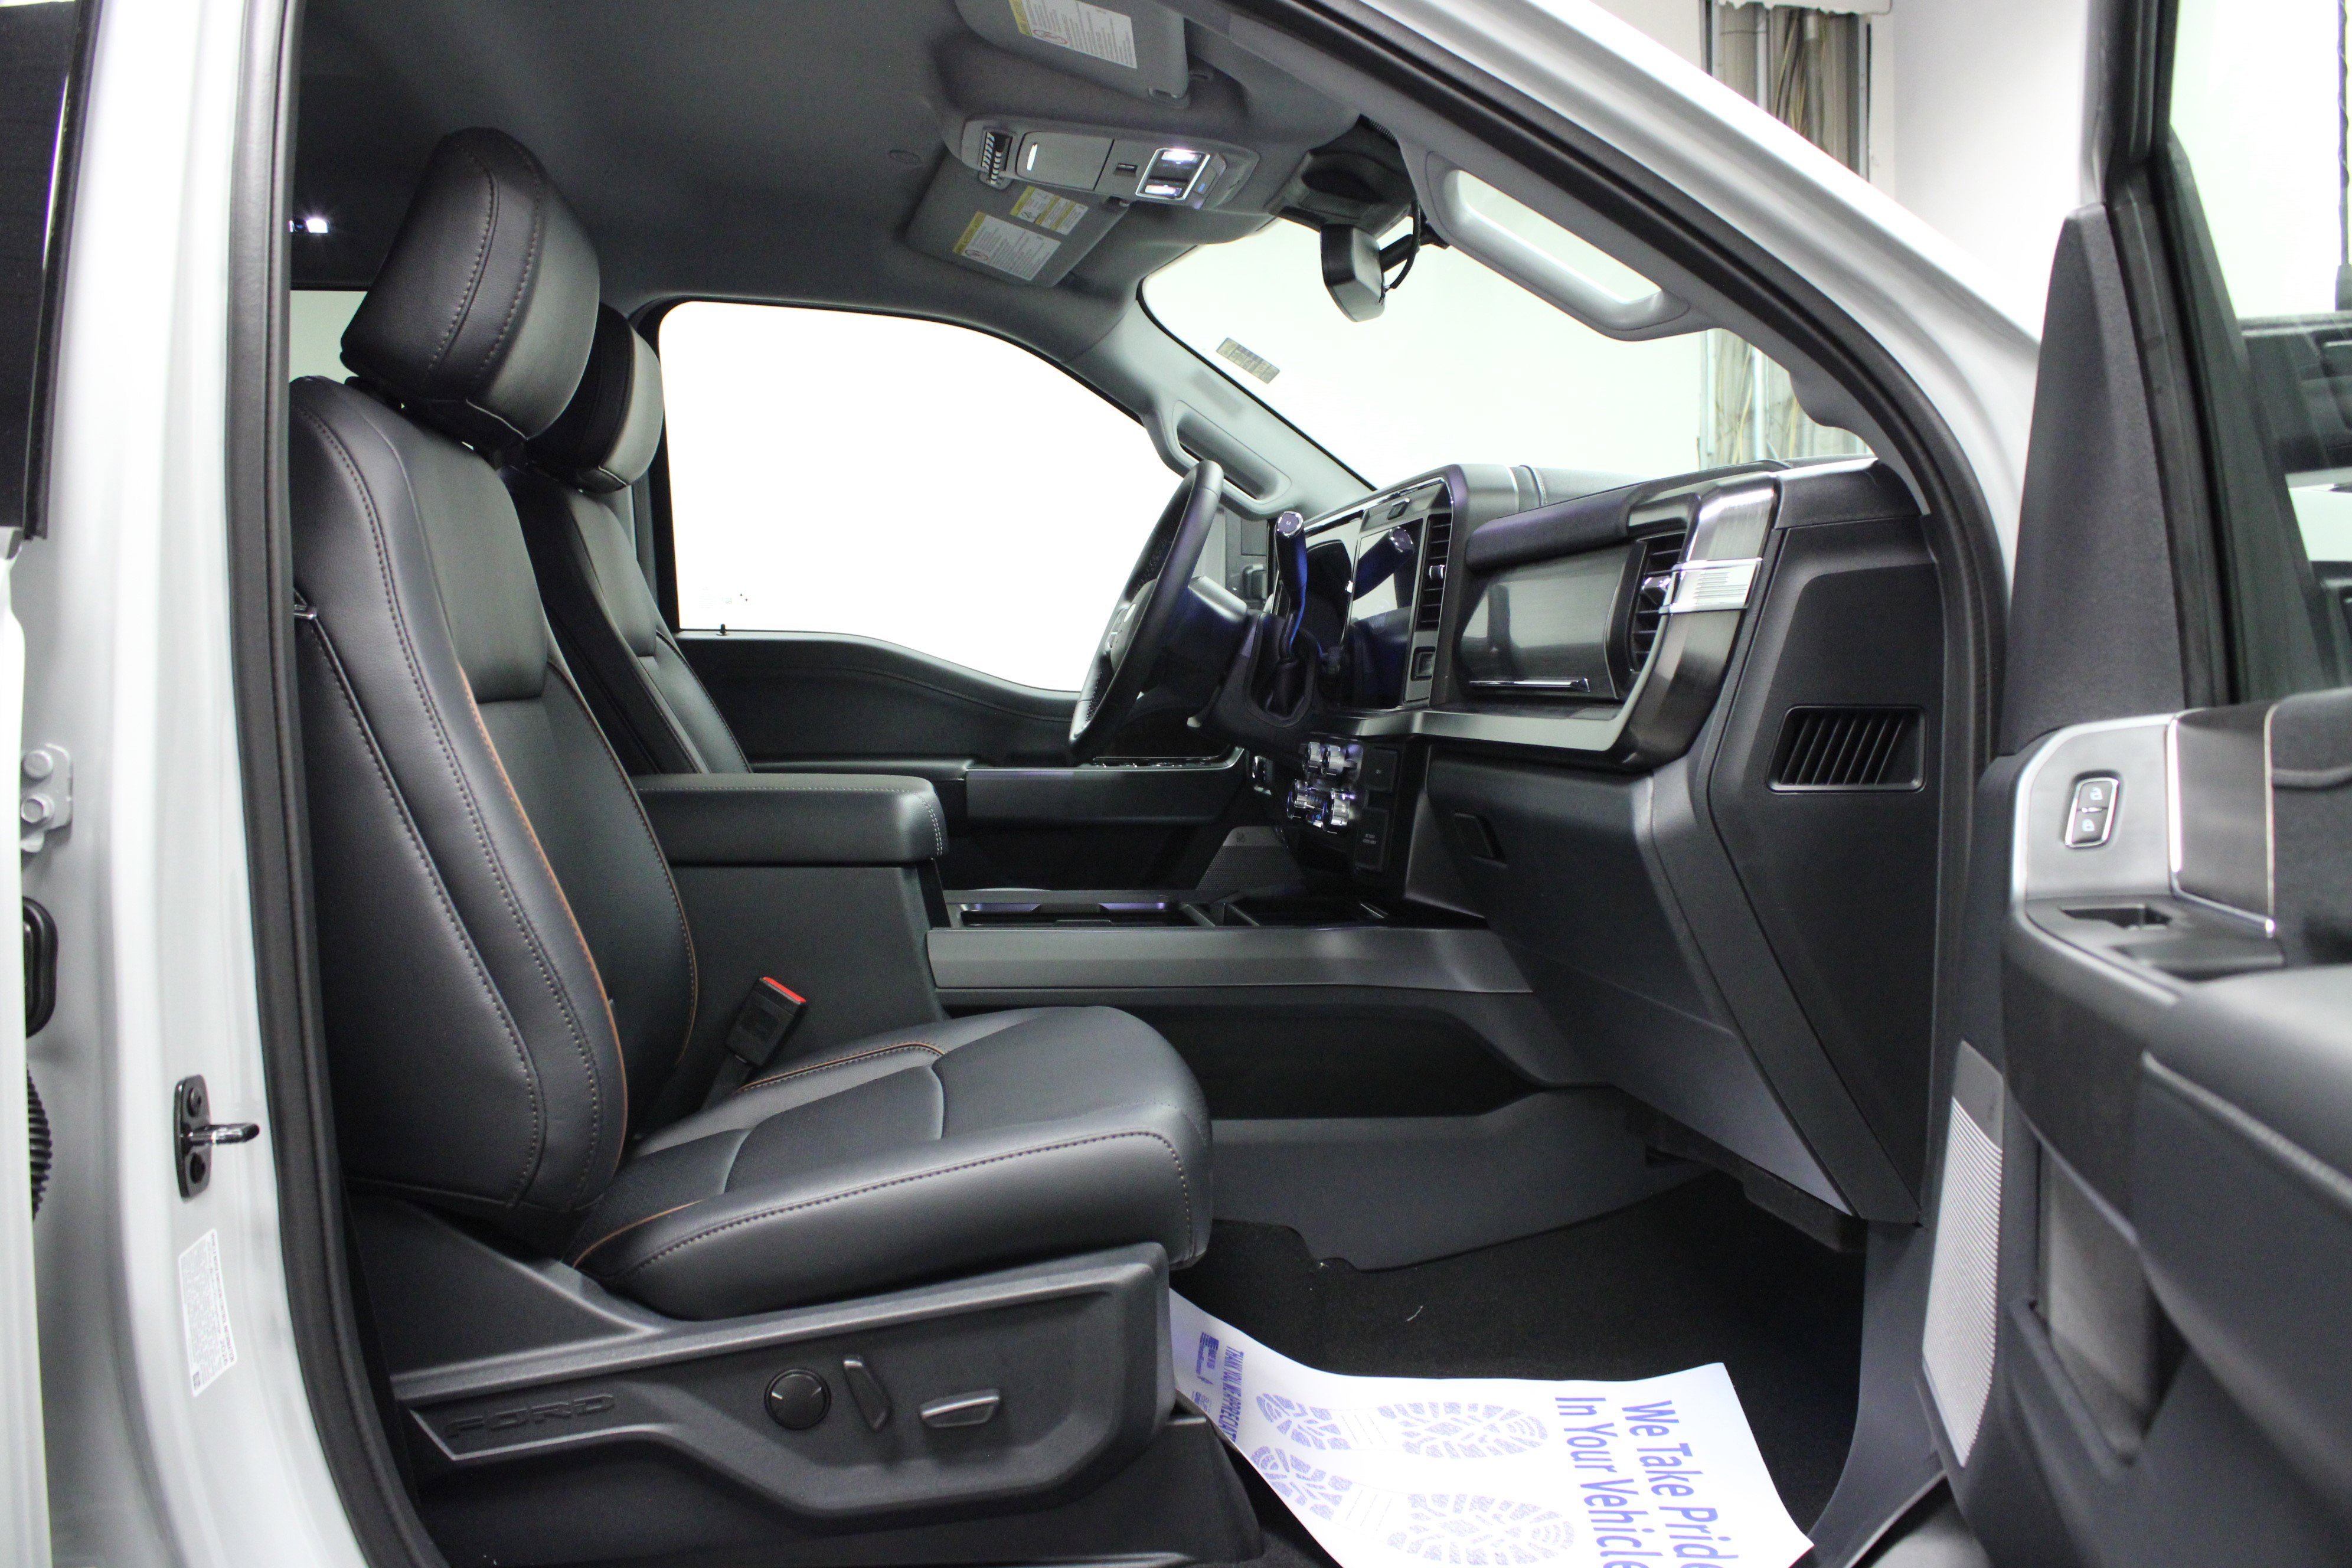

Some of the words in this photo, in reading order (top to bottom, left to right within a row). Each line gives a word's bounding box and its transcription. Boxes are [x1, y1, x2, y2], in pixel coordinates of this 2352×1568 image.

[1224, 1346, 1244, 1371] THANK
[446, 1393, 615, 1439] FORD
[1555, 1397, 1606, 1416] In
[1622, 1400, 1680, 1437] We
[1564, 1422, 1618, 1474] Your
[1637, 1443, 1703, 1498] Take
